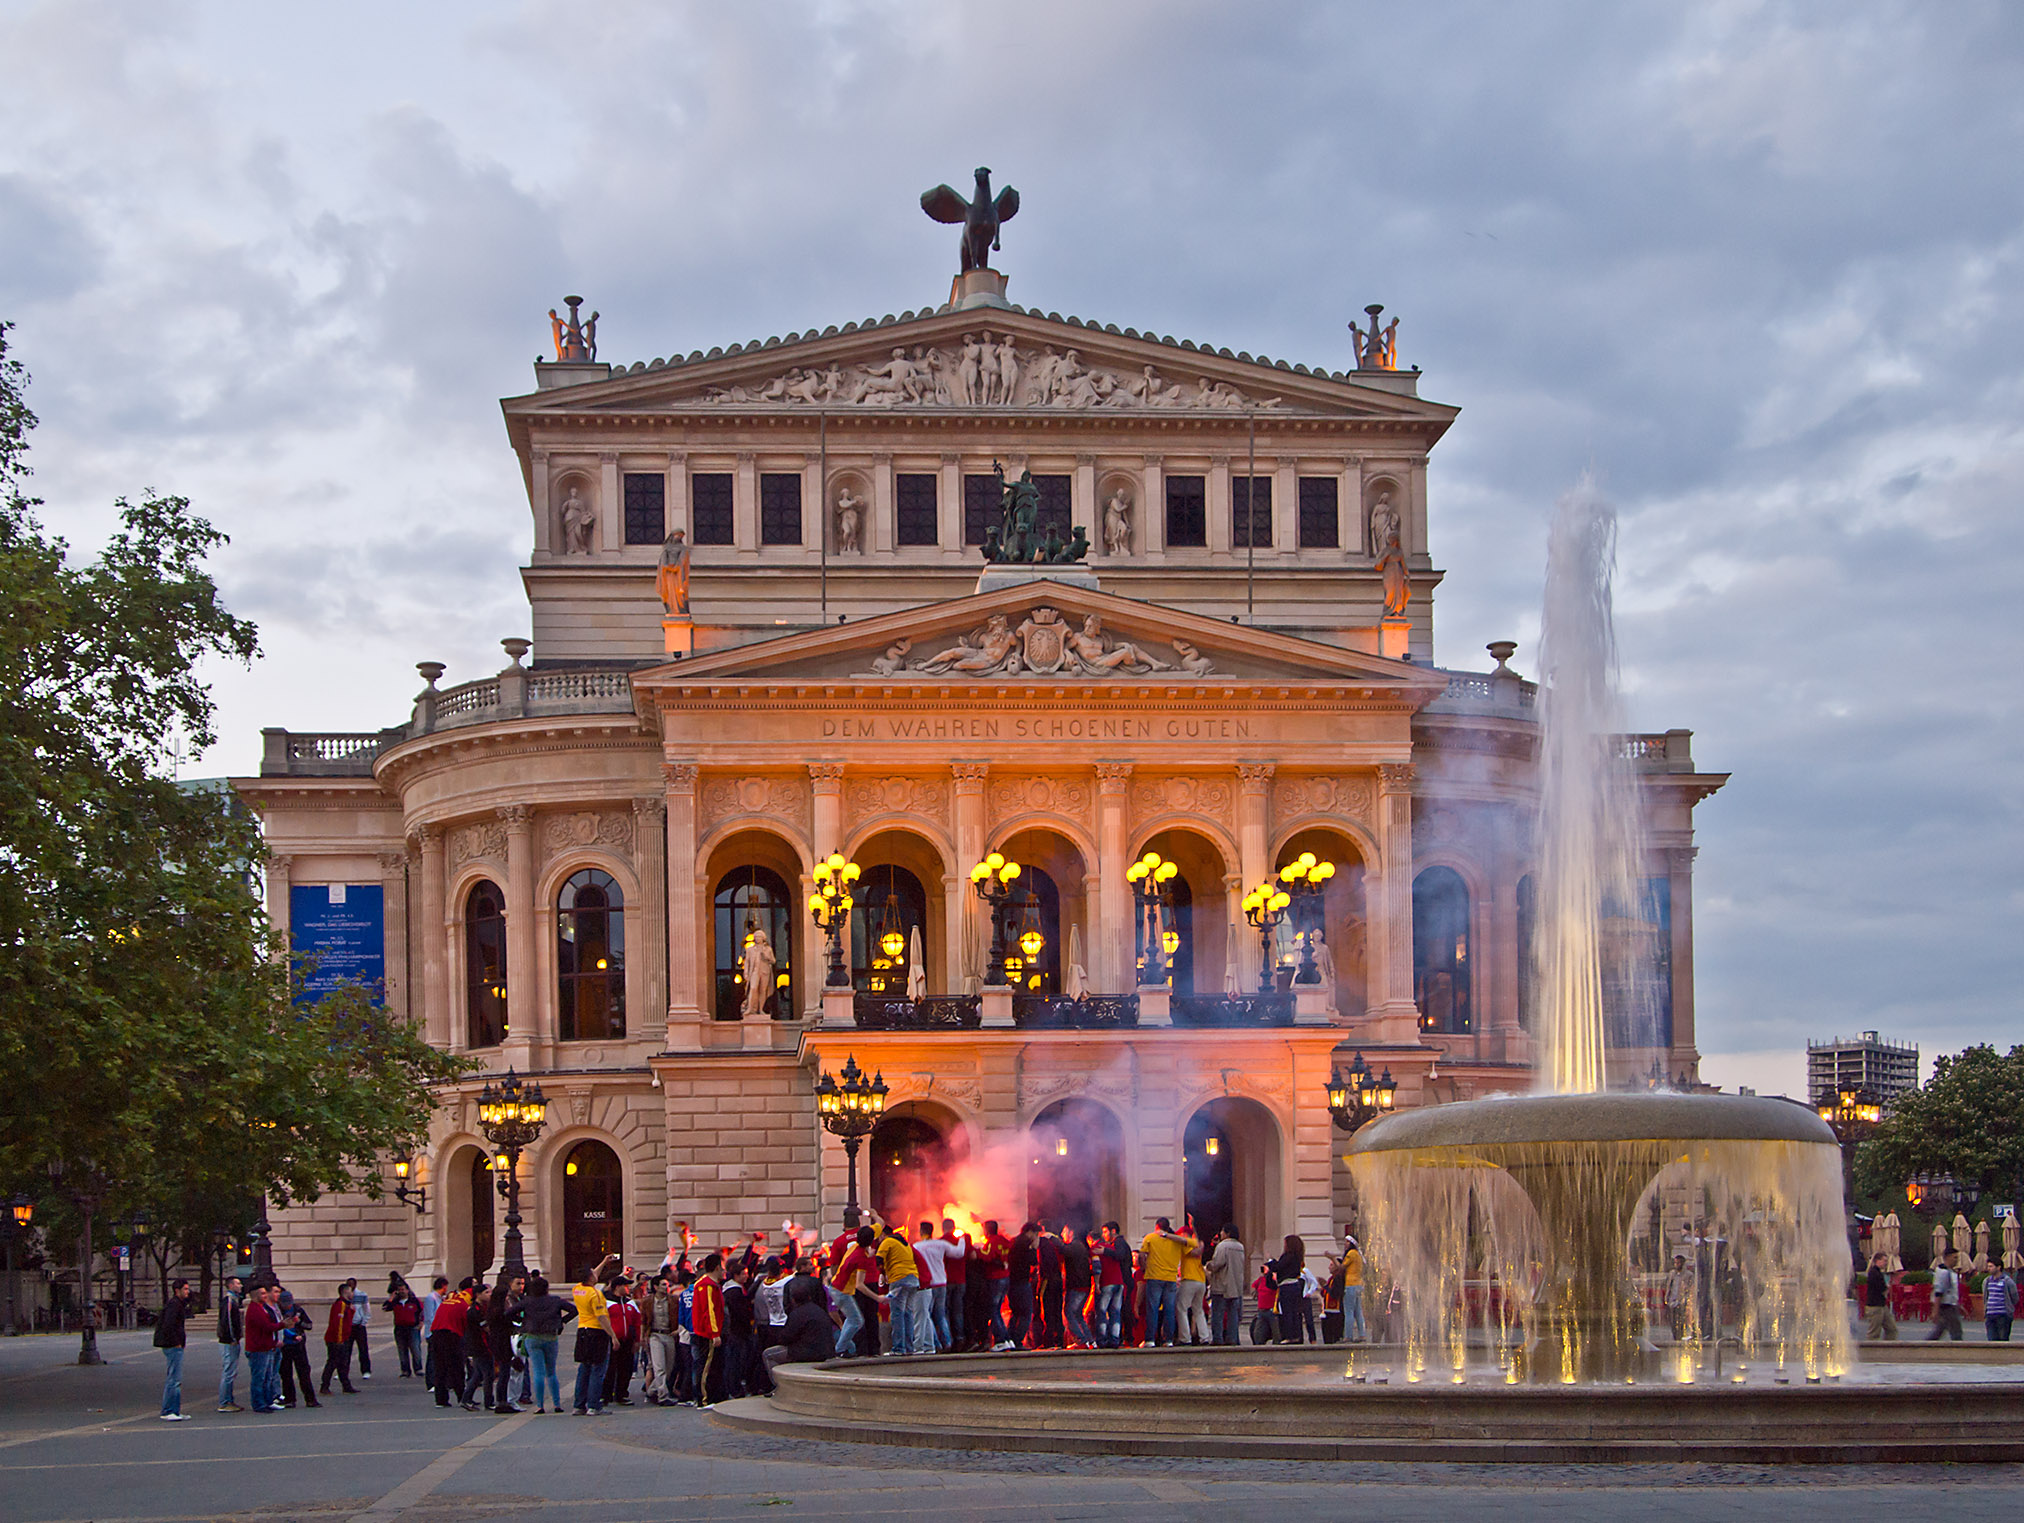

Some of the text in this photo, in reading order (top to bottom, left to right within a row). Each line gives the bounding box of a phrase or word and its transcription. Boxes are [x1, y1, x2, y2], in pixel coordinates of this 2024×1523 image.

[822, 719, 876, 738] DEM
[889, 719, 999, 738] WAHREN
[1015, 719, 1151, 738] SCHOENEN
[583, 1211, 606, 1219] KASSE
